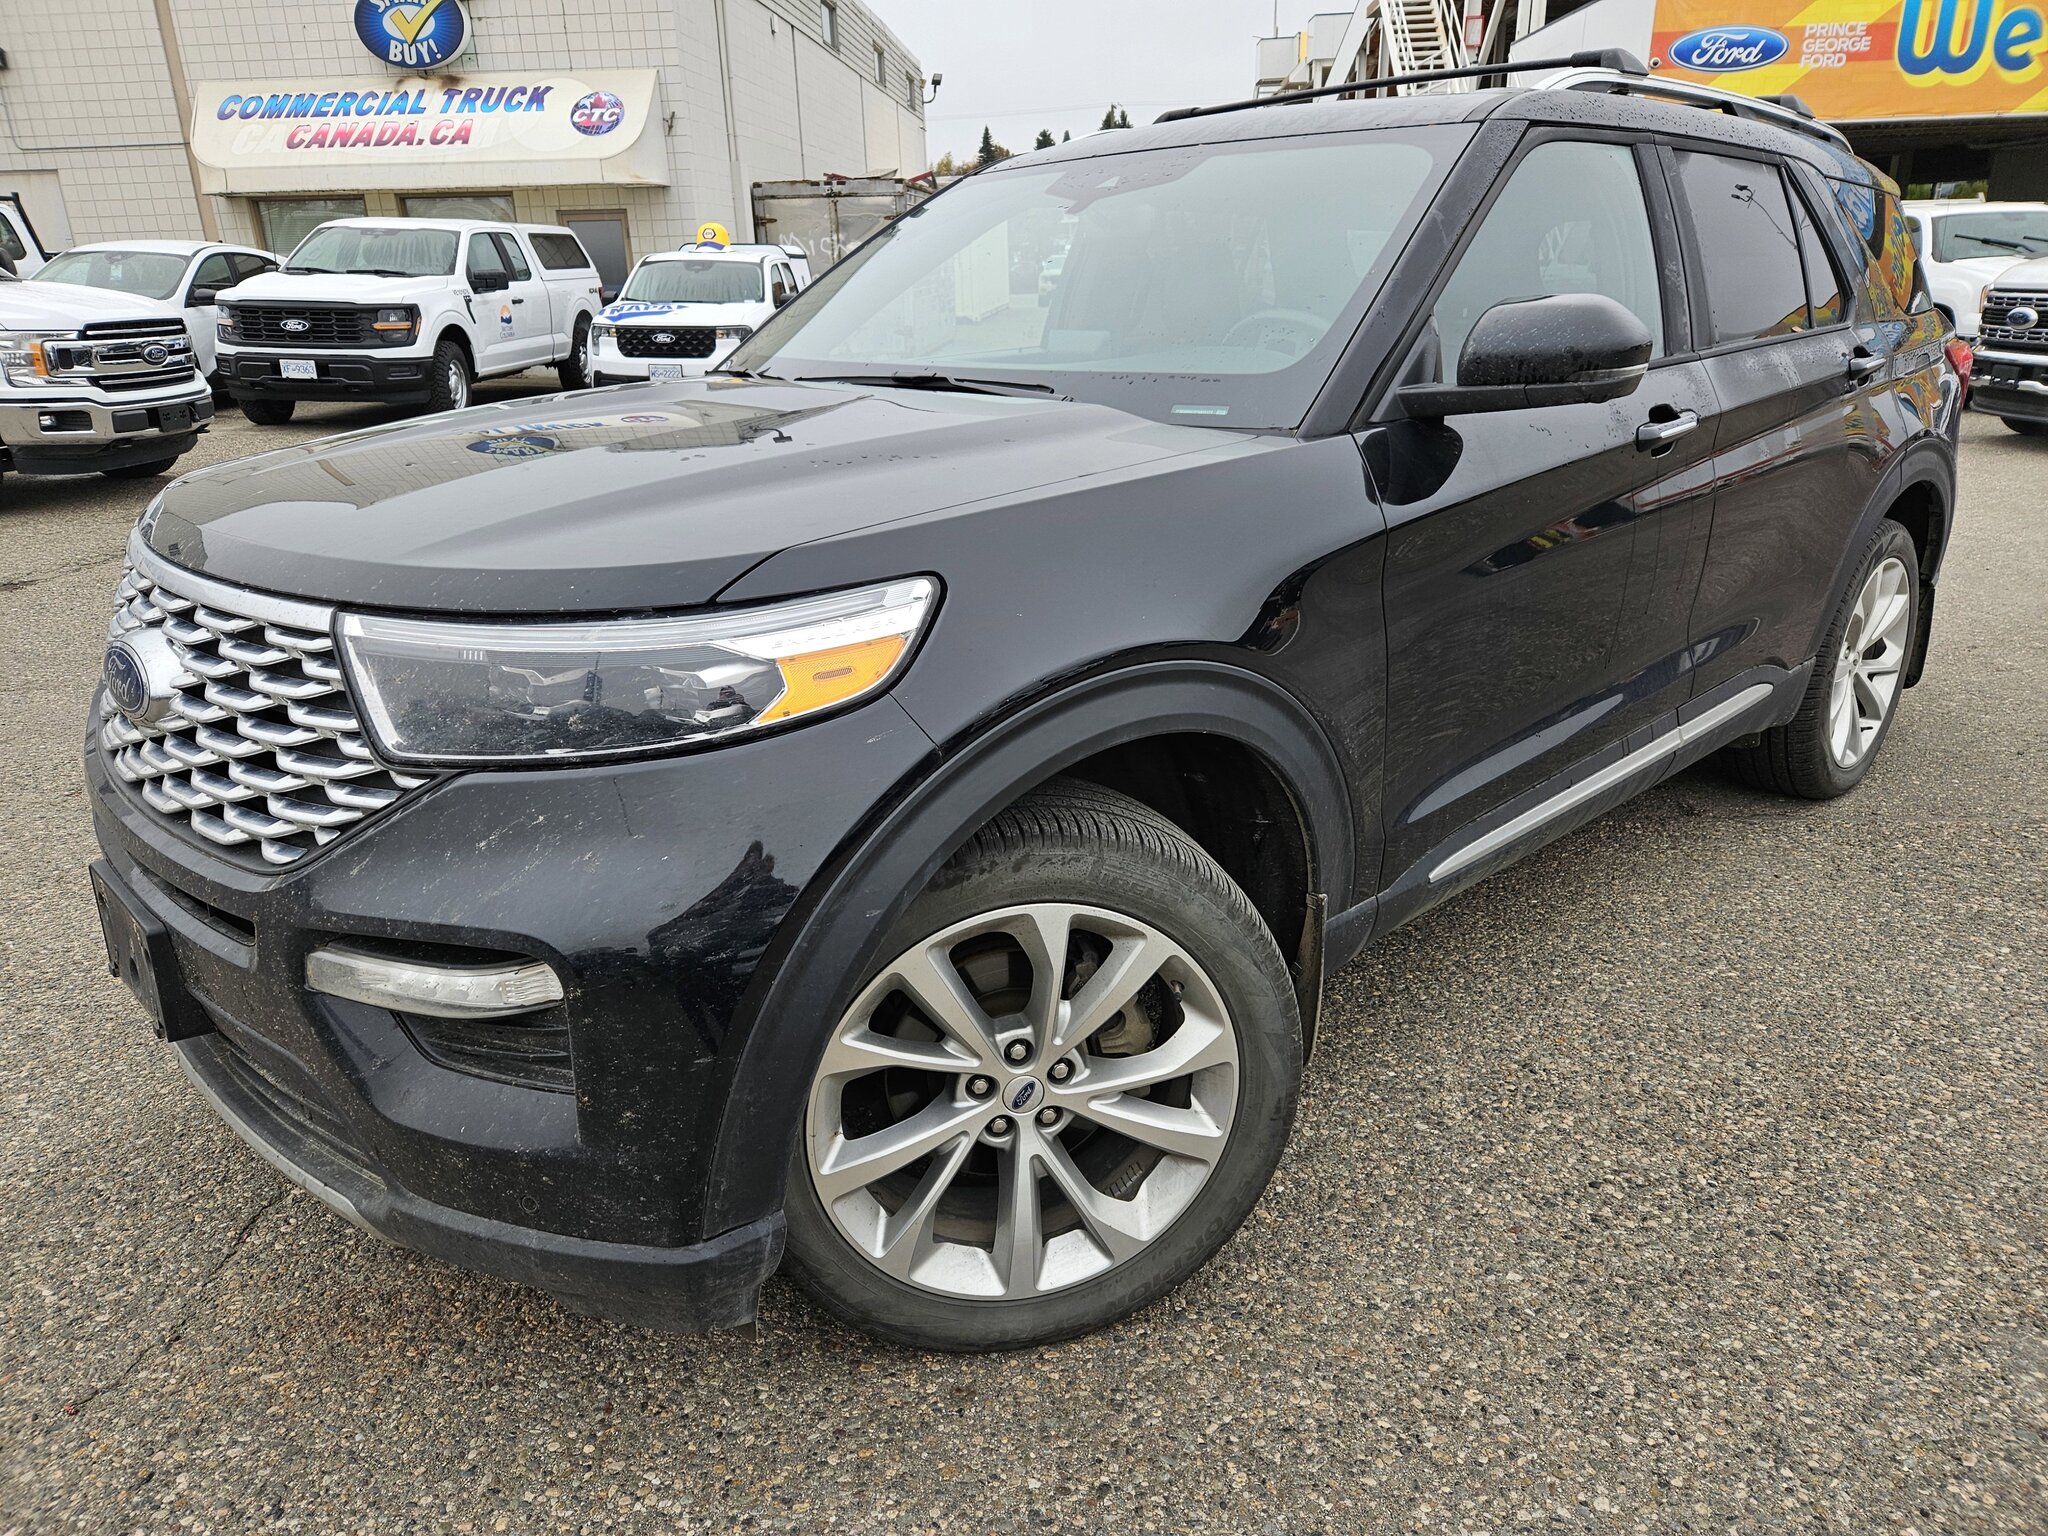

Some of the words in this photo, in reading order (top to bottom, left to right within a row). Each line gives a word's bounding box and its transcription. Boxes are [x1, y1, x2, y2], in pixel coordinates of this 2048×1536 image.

[1804, 22, 1868, 38] PRINCE
[388, 38, 442, 65] BUY!
[1691, 32, 1767, 65] Ford
[1802, 36, 1873, 53] GEORGE
[1800, 53, 1847, 69] FORD
[217, 89, 427, 120] COMMERCIAL
[439, 85, 555, 115] TRUCK
[572, 107, 620, 123] CTC
[286, 119, 473, 149] CANADA.CA
[105, 655, 131, 703] Ford
[1016, 1085, 1032, 1106] Ford
